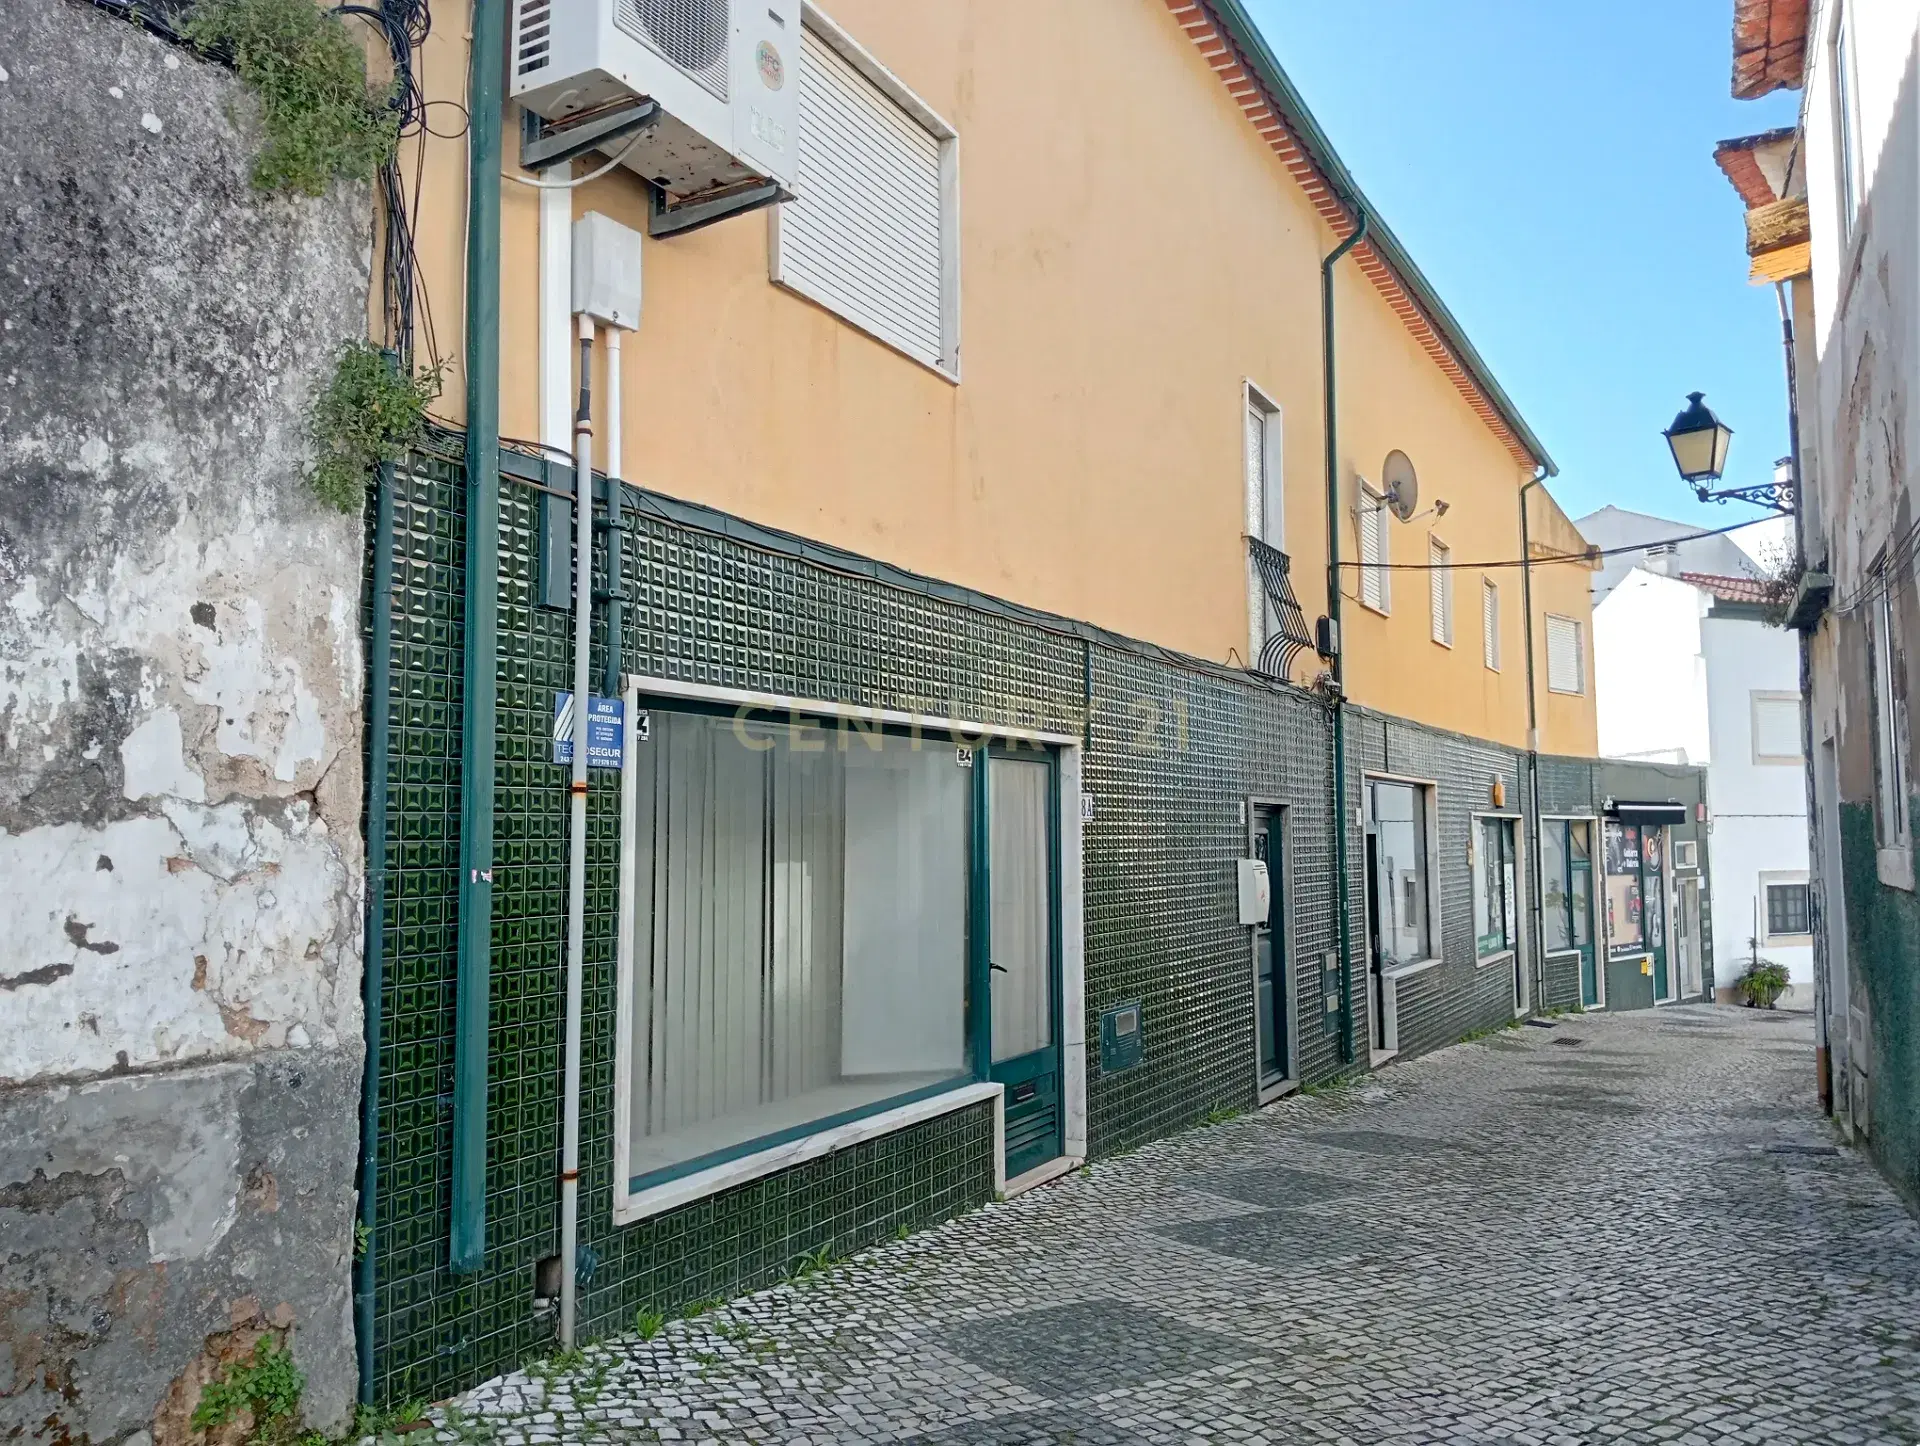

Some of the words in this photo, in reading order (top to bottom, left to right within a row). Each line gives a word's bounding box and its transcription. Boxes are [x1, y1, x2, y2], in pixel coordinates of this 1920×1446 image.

[597, 702, 614, 714] ÁREA
[588, 713, 622, 725] PROTEGIDA
[958, 749, 971, 762] 24
